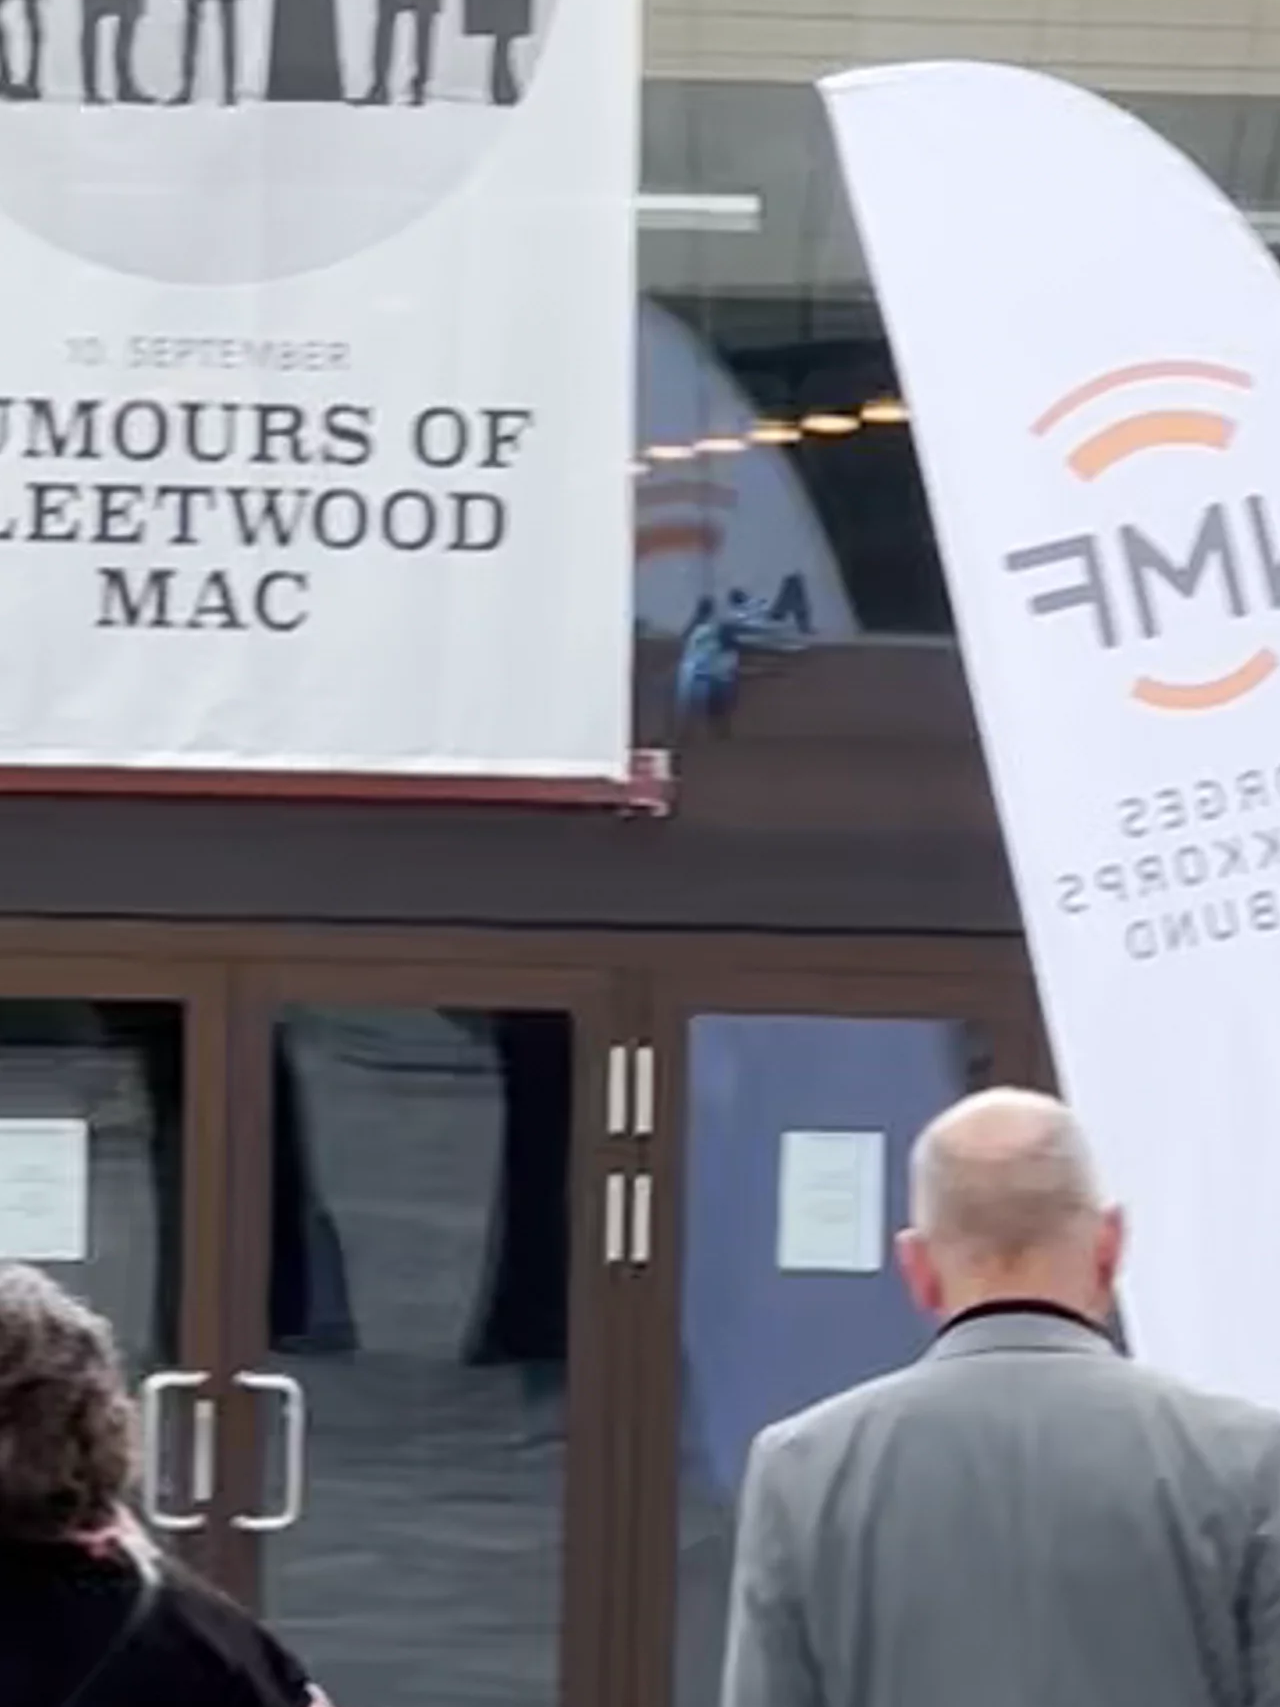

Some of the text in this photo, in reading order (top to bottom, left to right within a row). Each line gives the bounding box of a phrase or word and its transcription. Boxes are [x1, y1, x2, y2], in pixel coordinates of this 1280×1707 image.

[127, 334, 352, 373] SEPTEMBER
[410, 406, 535, 470] OF
[95, 567, 312, 634] MAC
